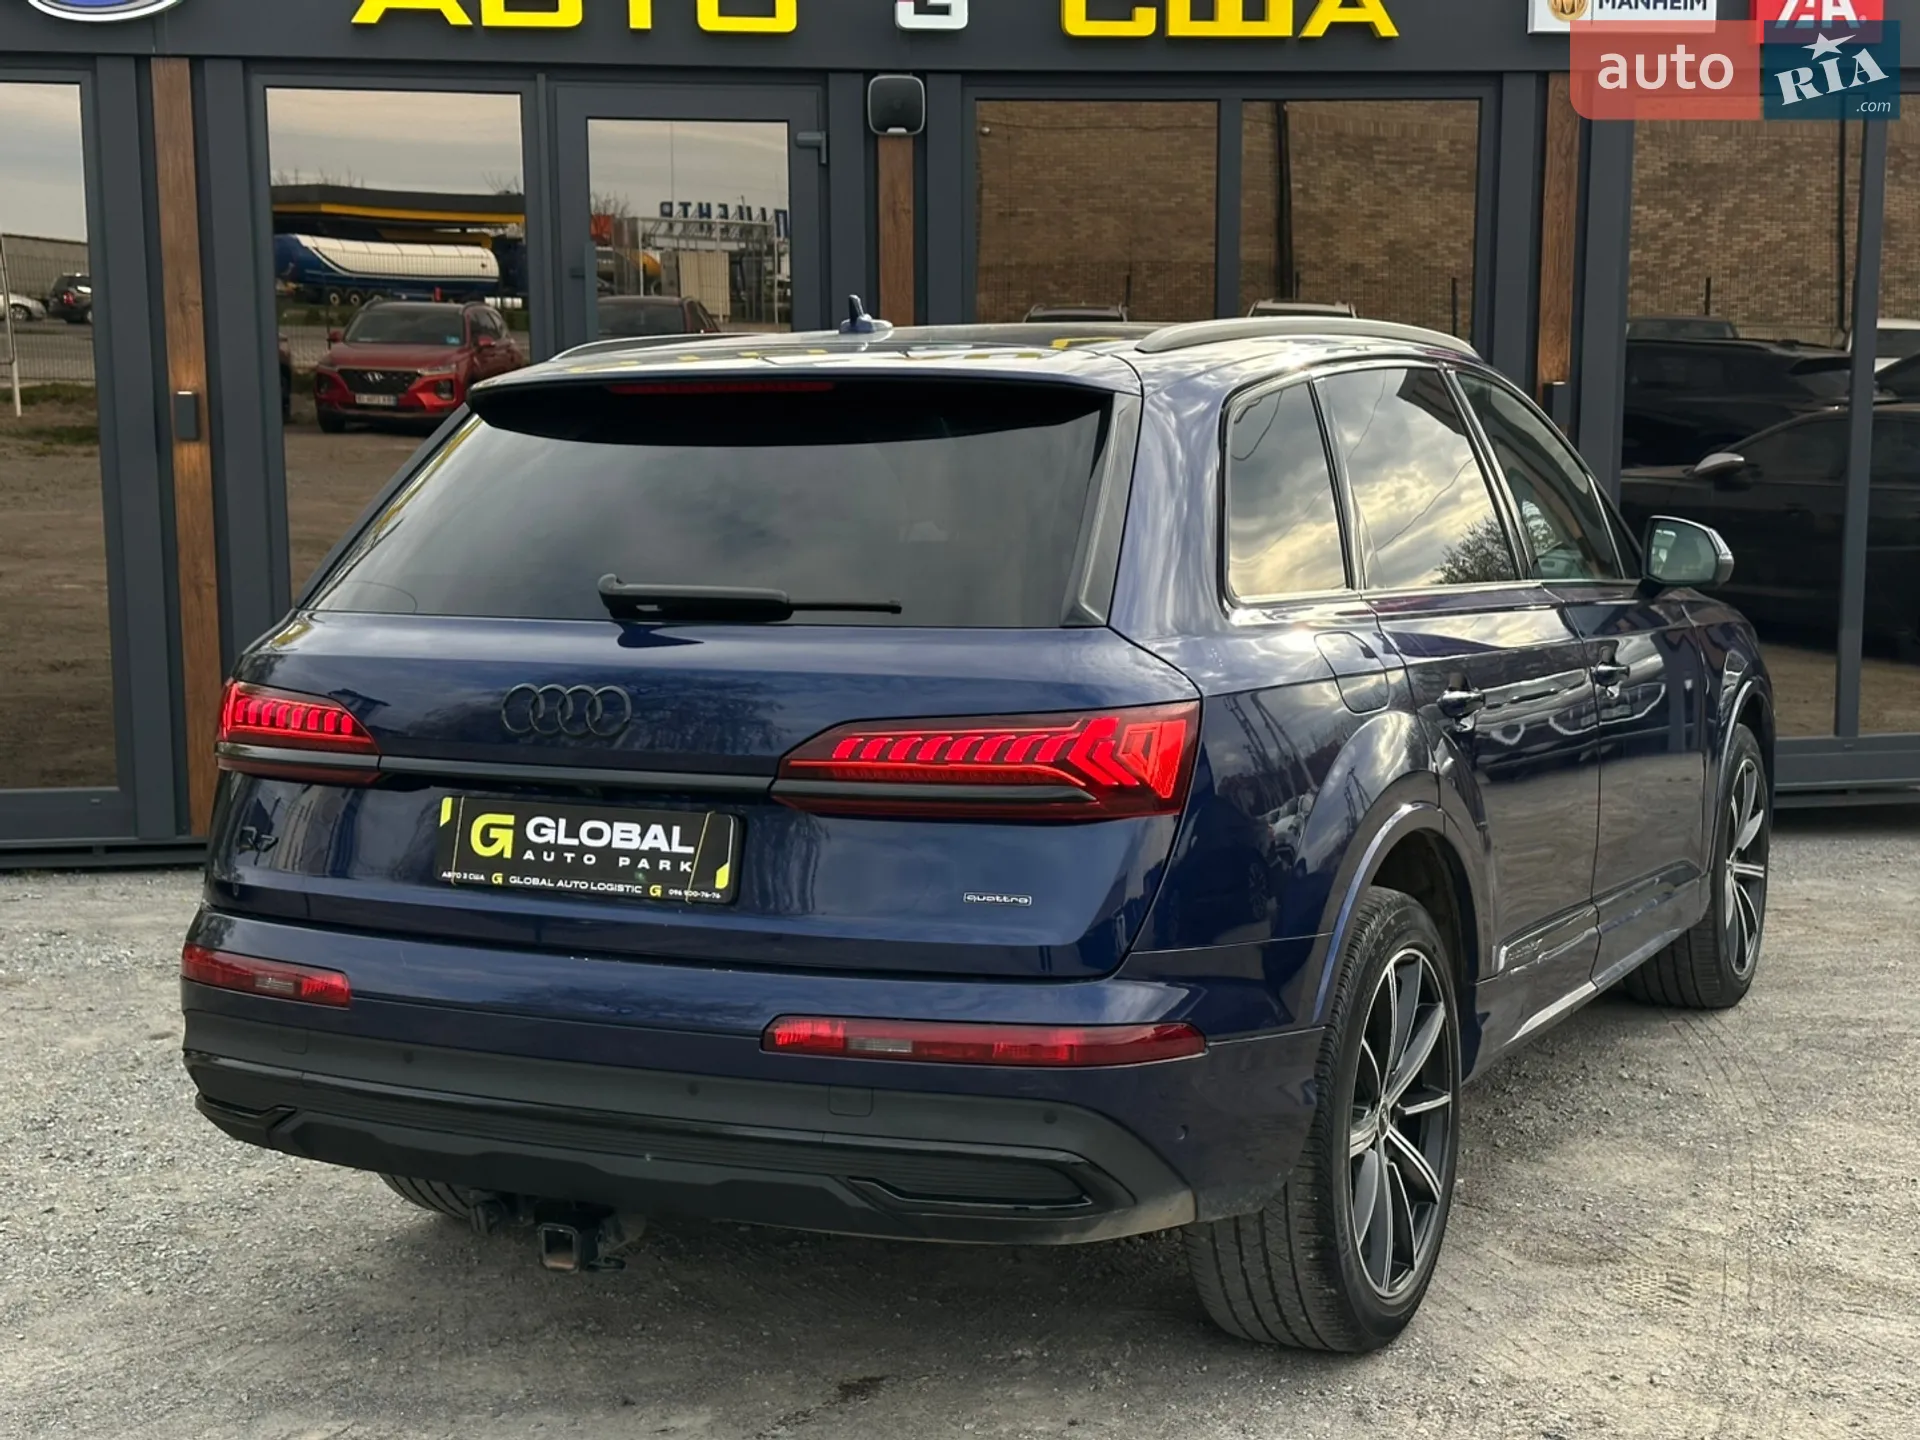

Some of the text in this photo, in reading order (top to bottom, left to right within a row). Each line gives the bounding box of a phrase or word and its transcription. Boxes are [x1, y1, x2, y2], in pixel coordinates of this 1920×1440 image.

[525, 816, 695, 854] GLOBAL
[523, 850, 692, 873] AUTO PARK
[508, 875, 643, 894] GLOBAL AUTO LOGISTIC
[966, 893, 1029, 904] quattro
